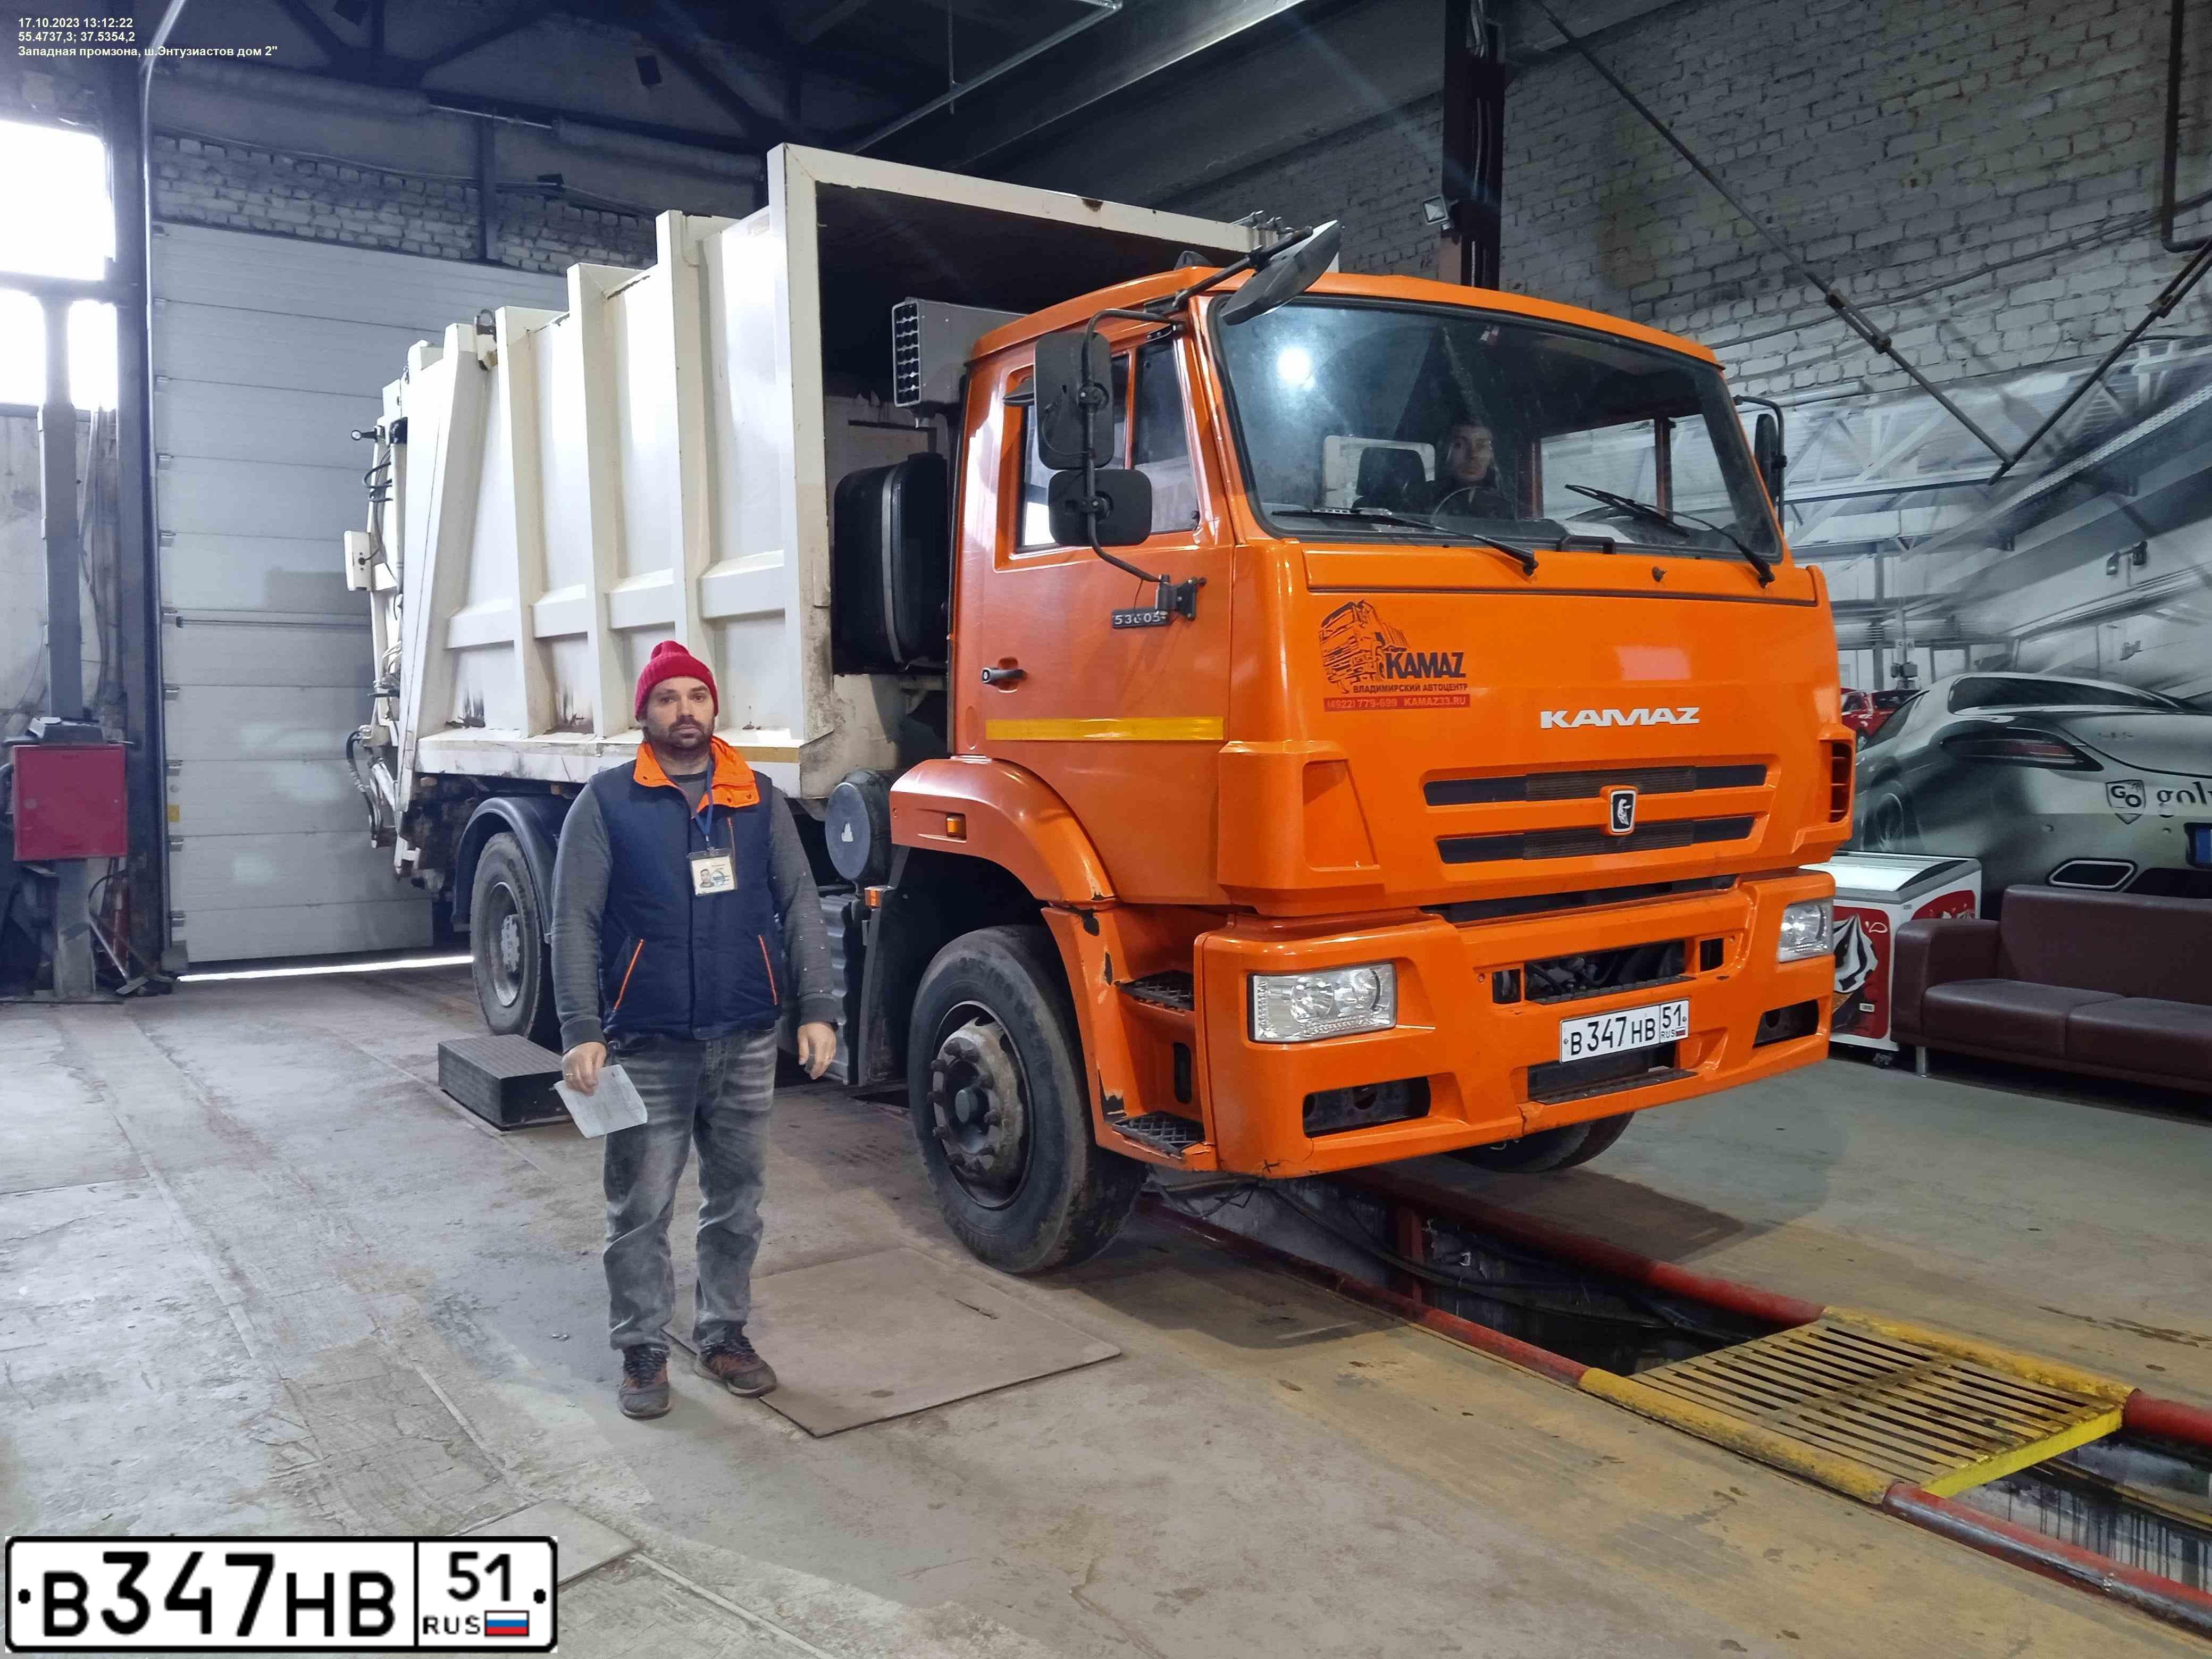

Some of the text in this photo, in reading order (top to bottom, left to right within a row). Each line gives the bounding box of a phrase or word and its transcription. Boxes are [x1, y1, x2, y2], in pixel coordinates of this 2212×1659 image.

[1386, 652, 1466, 679] KAMAZ
[1353, 683, 1468, 693] ВЛАДИМИРСКИЙ АВТОЦЕНТР
[1540, 707, 1700, 729] KAMAZ
[2157, 781, 2212, 818] gol
[1662, 1004, 1681, 1028] 51
[1661, 1029, 1675, 1038] RUS
